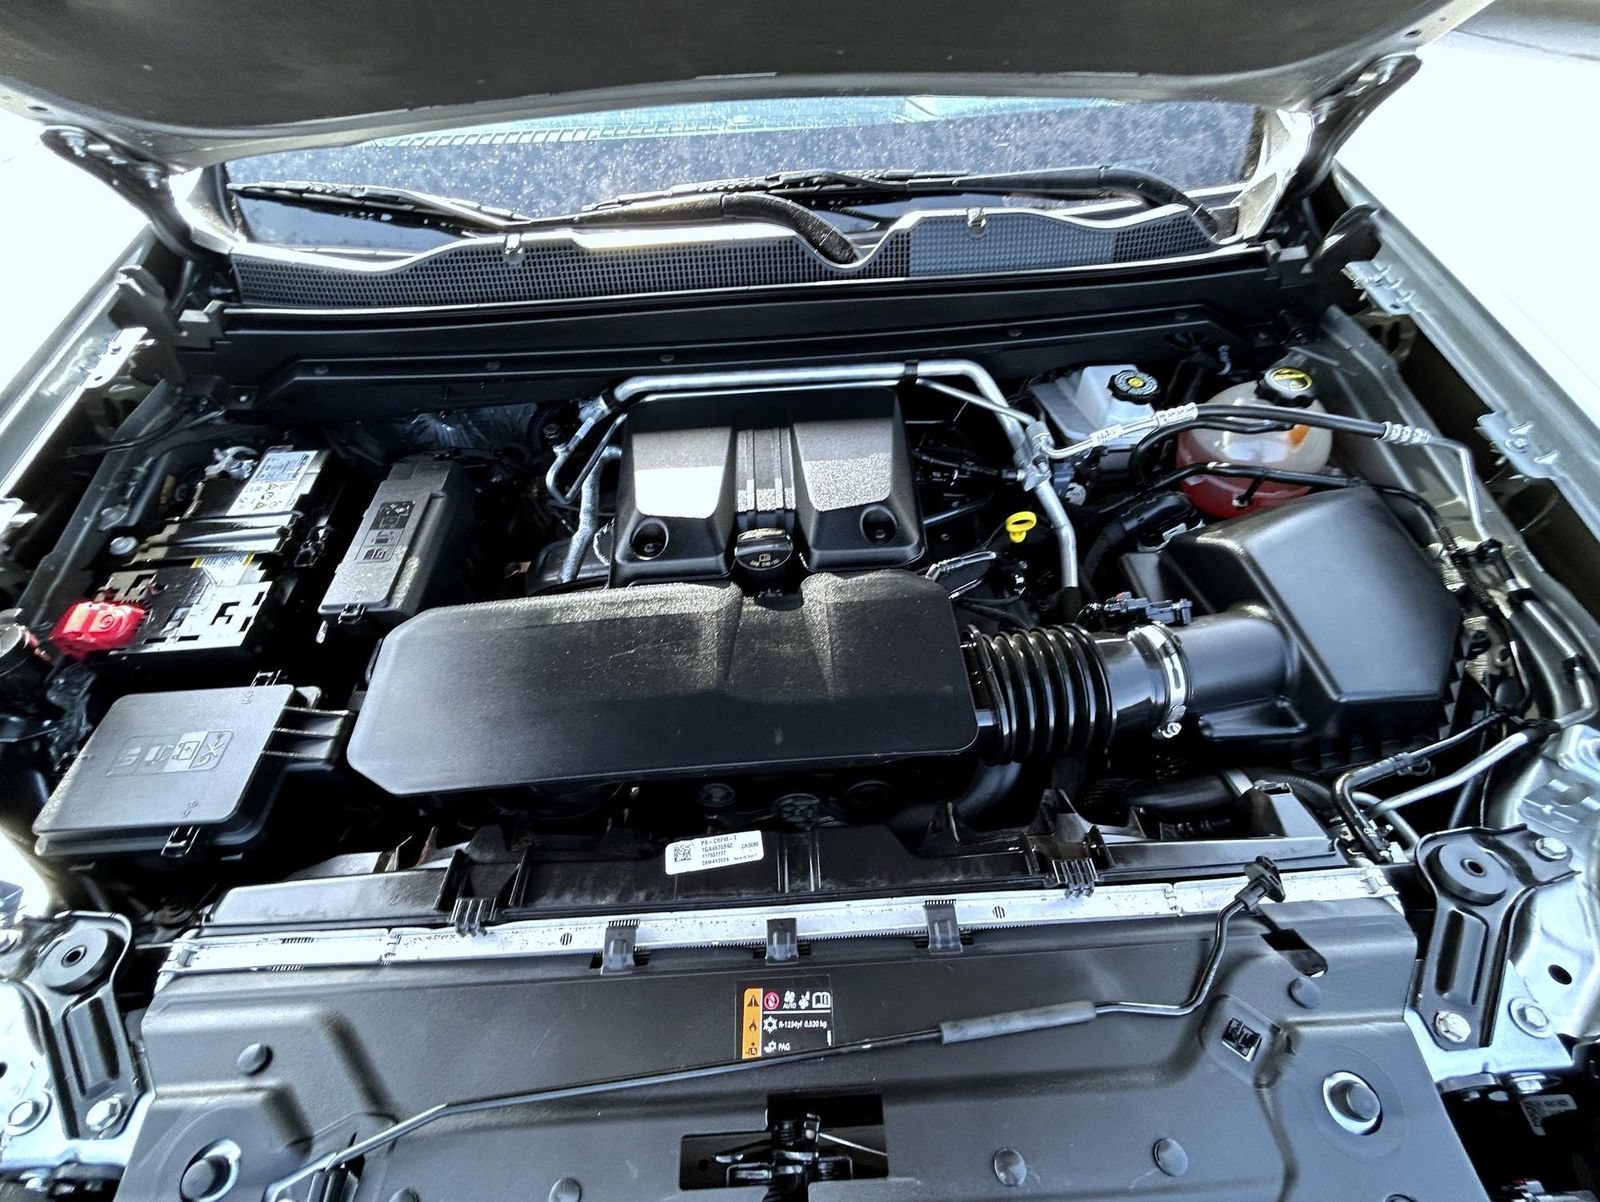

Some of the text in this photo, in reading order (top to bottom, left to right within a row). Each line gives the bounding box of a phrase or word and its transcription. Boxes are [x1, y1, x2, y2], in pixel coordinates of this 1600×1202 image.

[783, 1002, 797, 1010] AUTO
[778, 1019, 803, 1030] R-1234yf
[819, 1019, 828, 1030] kg
[778, 1042, 791, 1051] PAG
